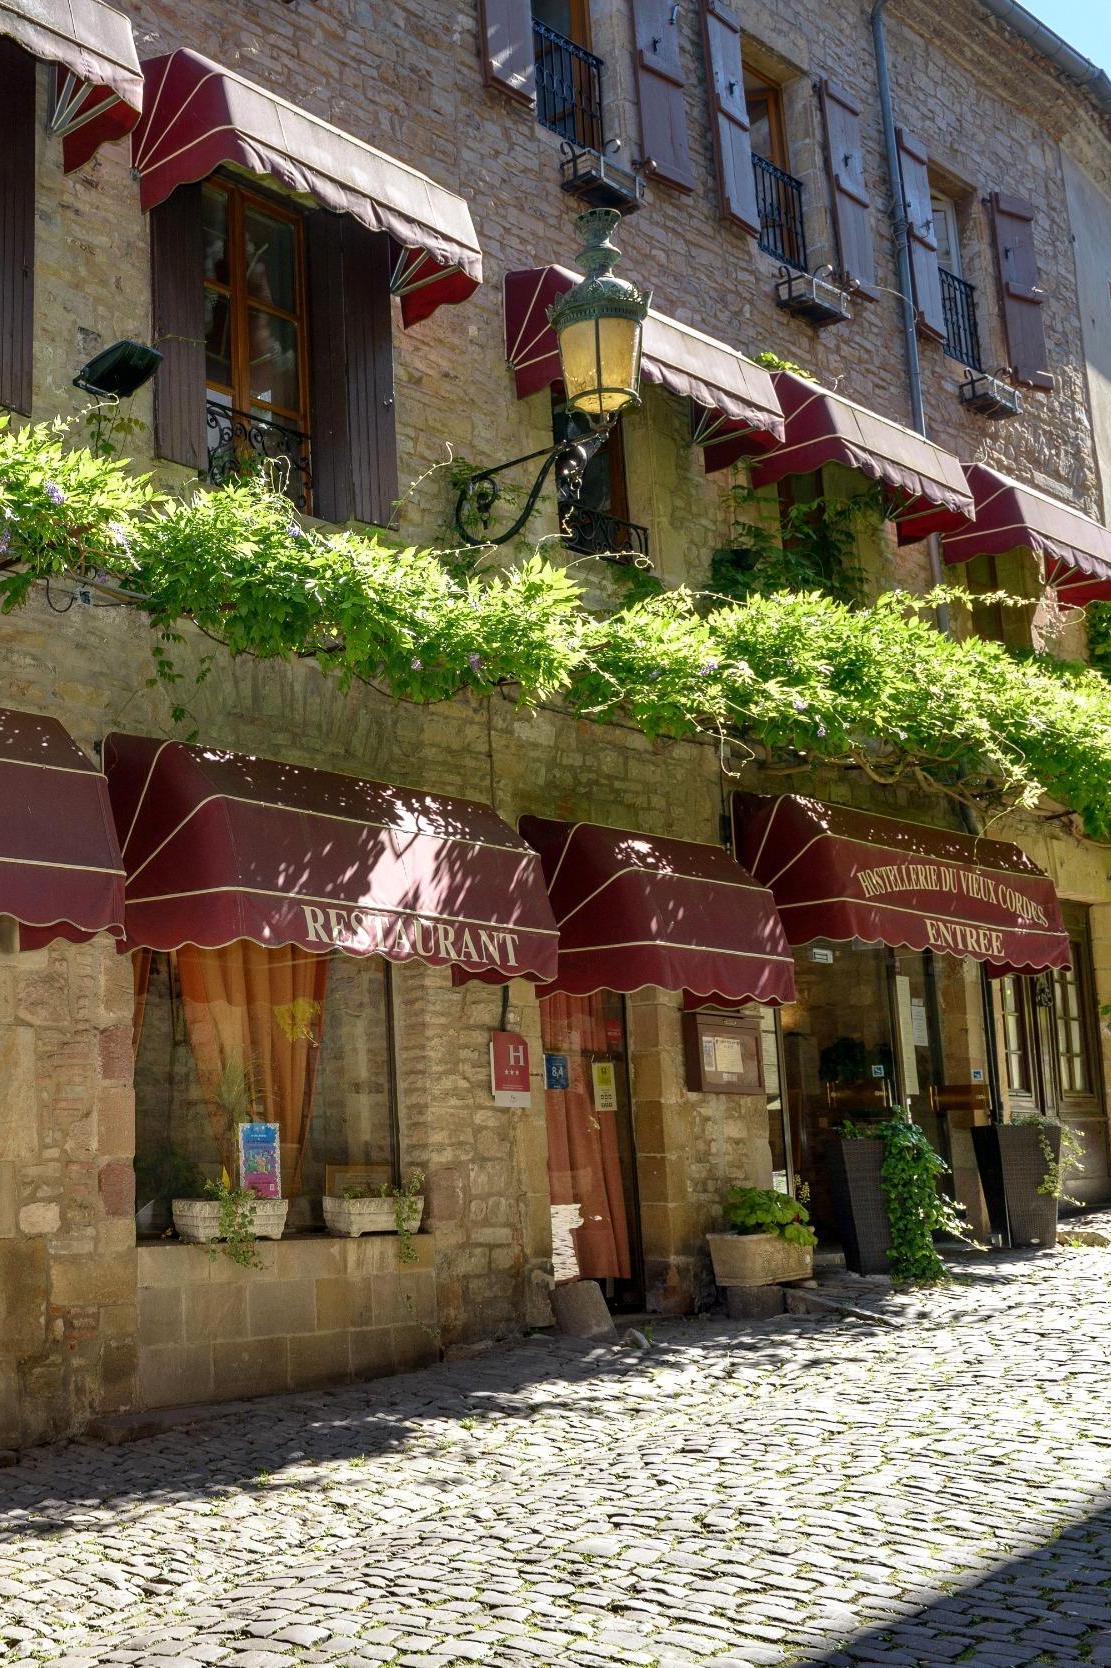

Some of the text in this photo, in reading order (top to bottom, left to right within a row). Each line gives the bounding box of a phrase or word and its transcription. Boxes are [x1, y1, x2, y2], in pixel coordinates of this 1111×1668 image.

[856, 864, 1049, 928] HOSTELLERIE DU VIEUX CORDES
[300, 904, 520, 967] RESTAURANT
[925, 918, 1006, 957] ENTRÉE
[507, 1044, 525, 1067] H
